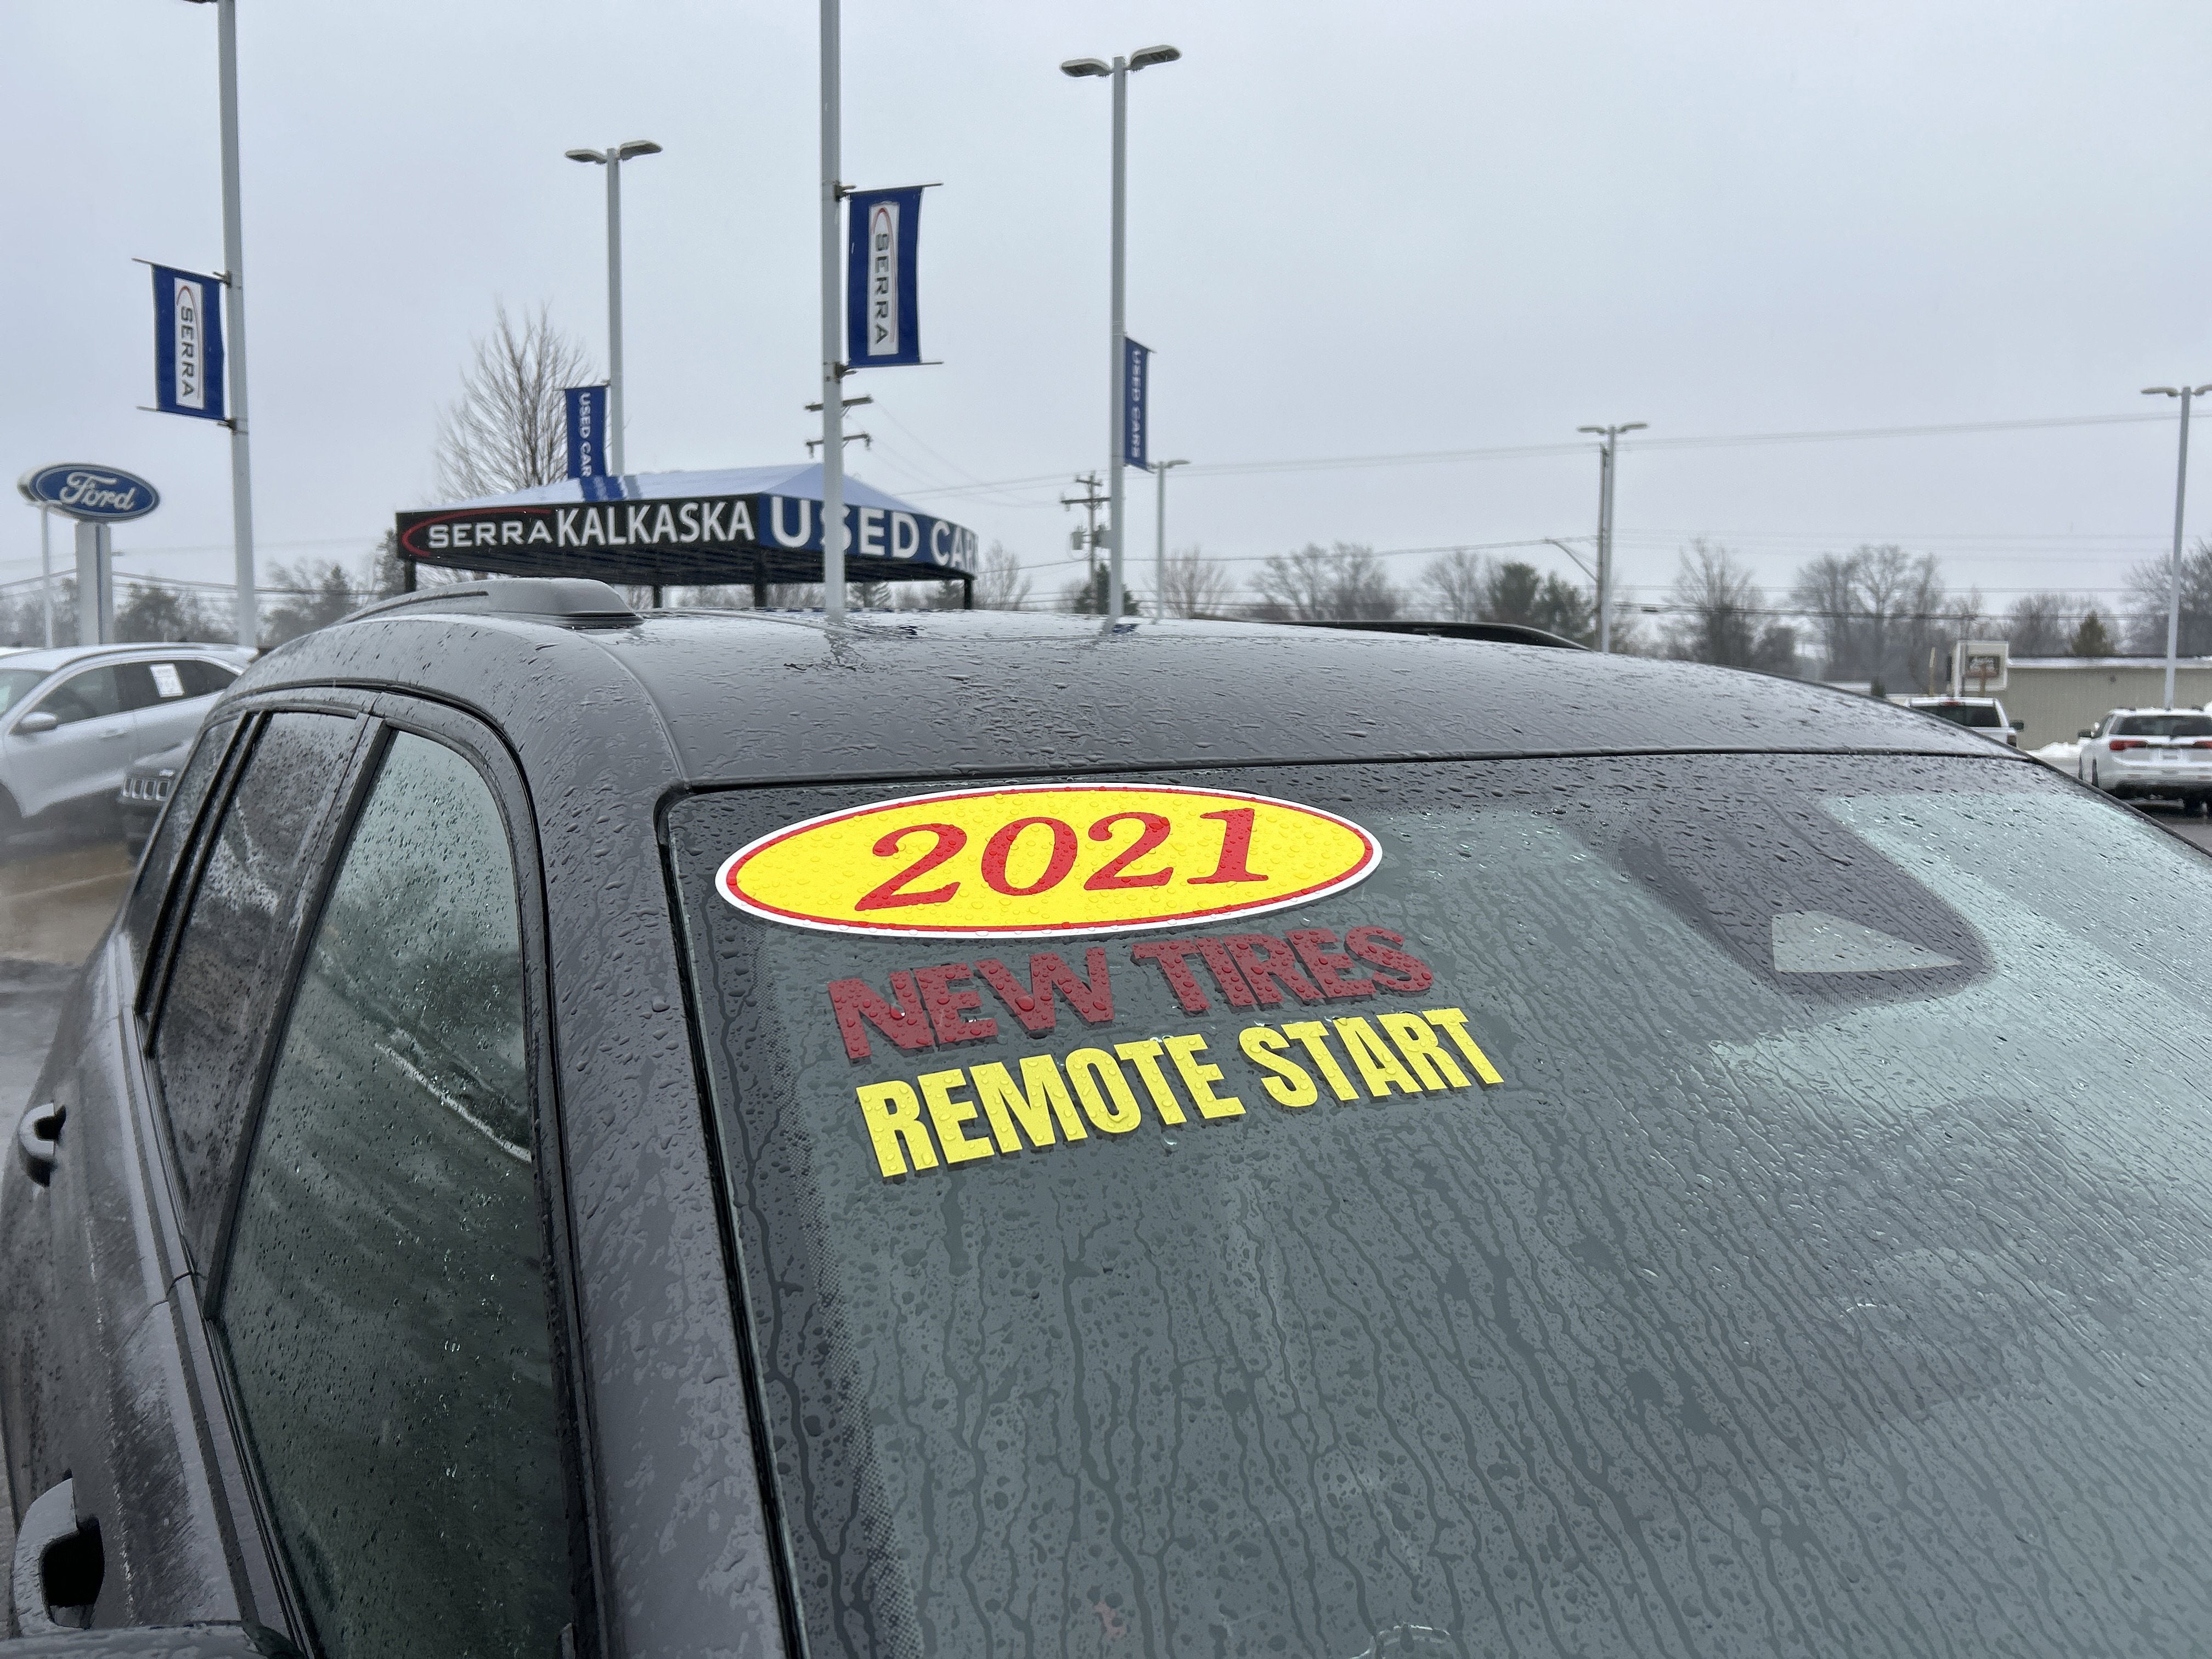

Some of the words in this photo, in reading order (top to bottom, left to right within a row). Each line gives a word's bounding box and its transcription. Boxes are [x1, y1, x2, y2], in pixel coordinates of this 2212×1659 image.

[875, 233, 889, 343] SERRA
[180, 305, 194, 396] SERRA
[579, 392, 591, 438] USED
[59, 471, 136, 510] Ford
[427, 518, 553, 549] SERRA
[556, 499, 756, 548] KALKASKA
[854, 808, 1269, 912] 2021
[827, 947, 1114, 1060] NEW
[1130, 925, 1434, 1014] TIRES
[855, 1034, 1247, 1178] REMOTE
[1237, 1007, 1506, 1108] START
